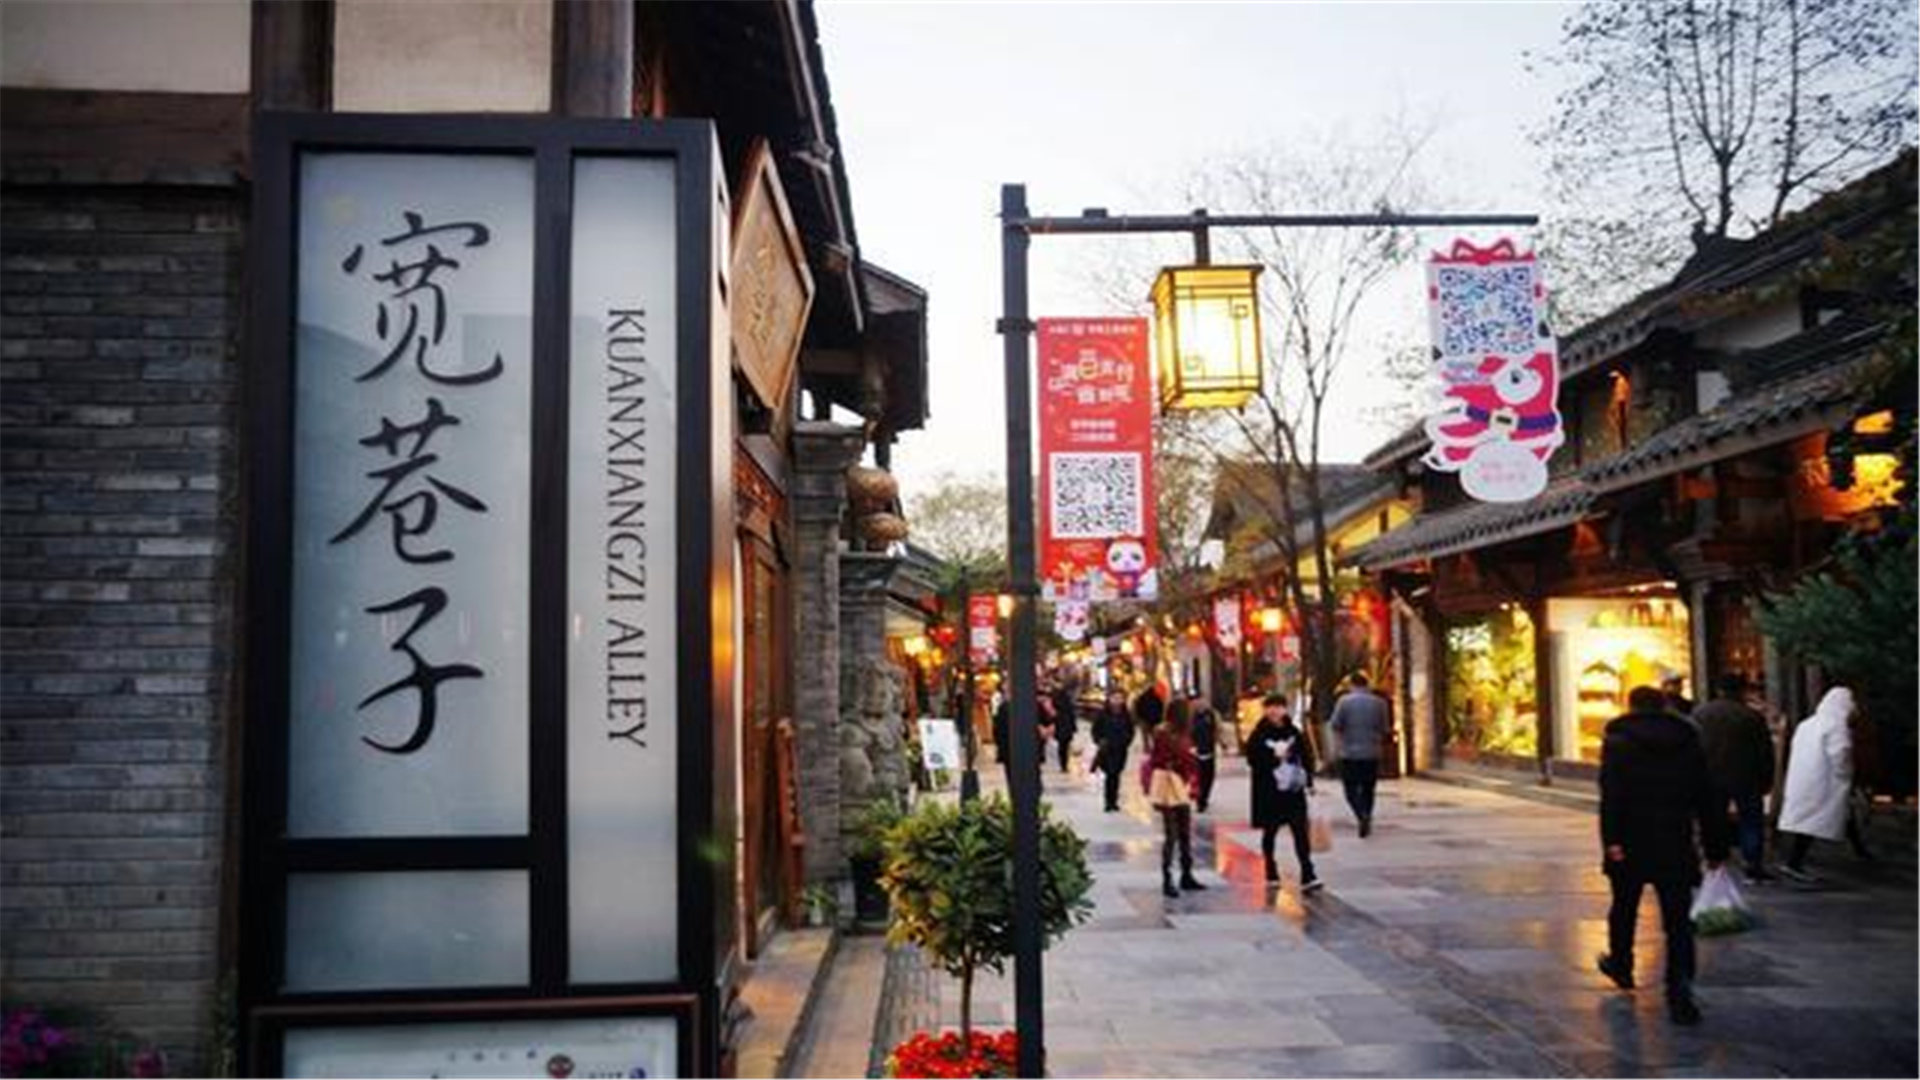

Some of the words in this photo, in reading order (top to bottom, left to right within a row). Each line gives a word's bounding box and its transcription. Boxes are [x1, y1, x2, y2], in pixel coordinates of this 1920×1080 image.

[329, 210, 504, 755] 宽巷子
[606, 308, 646, 602] KUANXIANGZI
[606, 618, 647, 748] ALLEY
